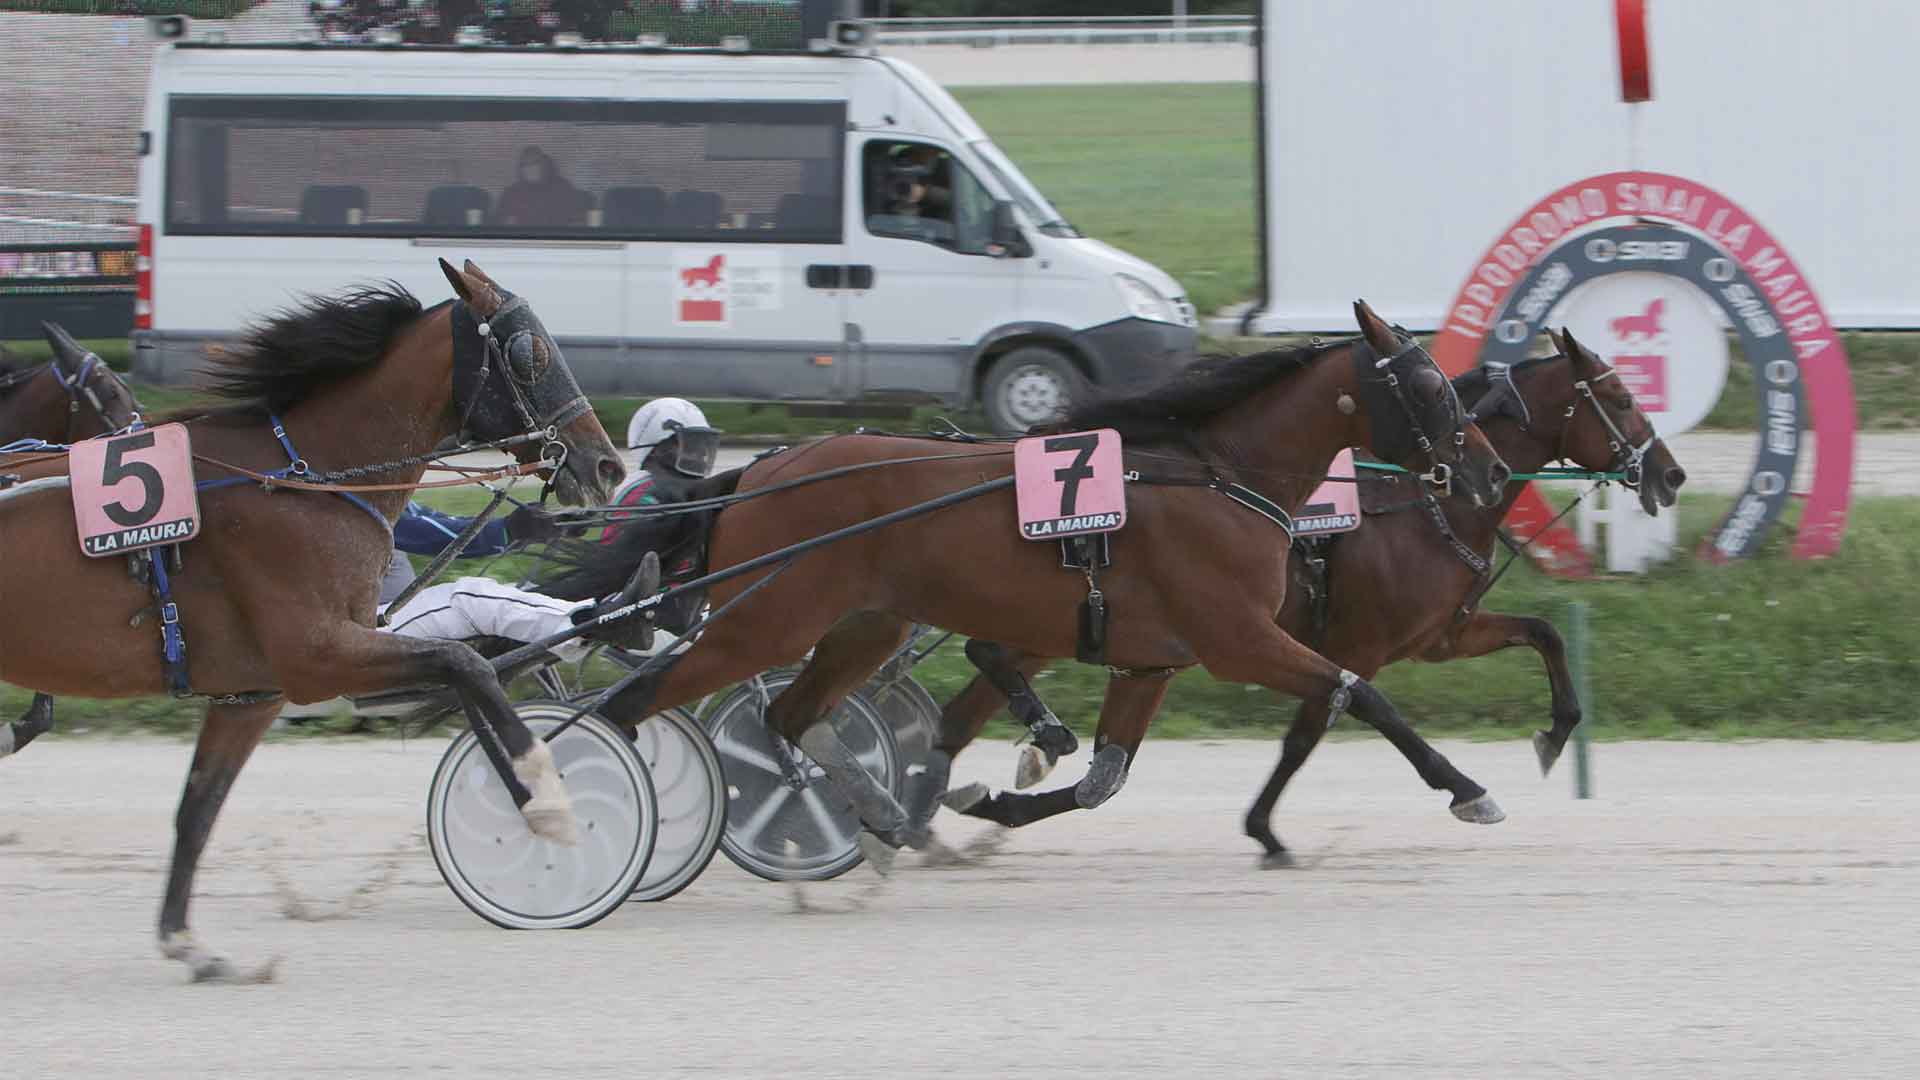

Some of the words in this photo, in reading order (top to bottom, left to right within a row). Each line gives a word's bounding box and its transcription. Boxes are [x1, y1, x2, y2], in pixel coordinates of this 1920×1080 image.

[1449, 188, 1607, 338] IPPODROMO
[1616, 182, 1706, 223] SNAI
[1707, 207, 1752, 251] LA
[1744, 247, 1831, 358] MAURA
[102, 432, 164, 526] 5
[1044, 433, 1099, 516] 7
[94, 535, 118, 551] LA
[122, 522, 189, 546] MAURA
[1031, 521, 1053, 535] LA
[1057, 513, 1117, 531] MAURA
[1298, 515, 1352, 531] MAURA
